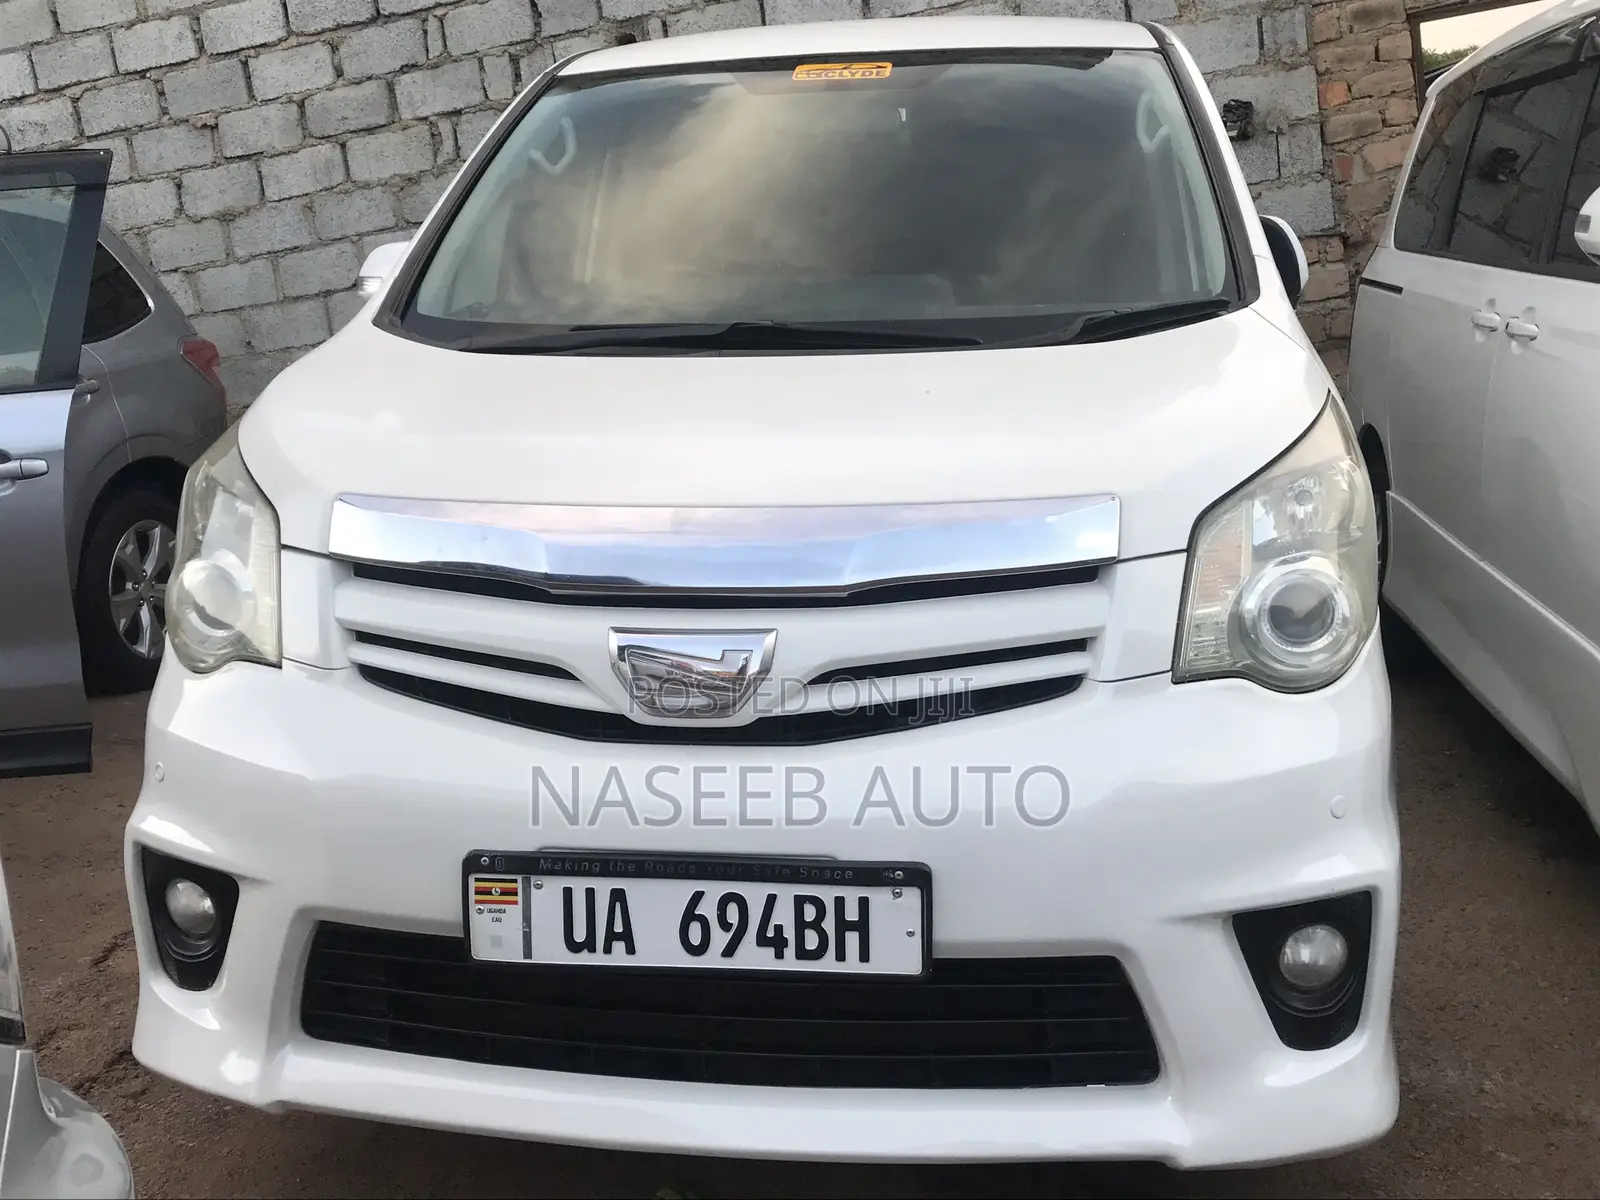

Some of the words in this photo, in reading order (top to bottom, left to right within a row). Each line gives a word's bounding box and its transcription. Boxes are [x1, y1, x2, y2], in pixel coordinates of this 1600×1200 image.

[823, 69, 887, 79] CLYDE
[539, 858, 601, 874] Making
[609, 860, 636, 872] the
[645, 861, 696, 874] Roads
[562, 886, 636, 956] UA
[678, 890, 871, 963] 694BH
